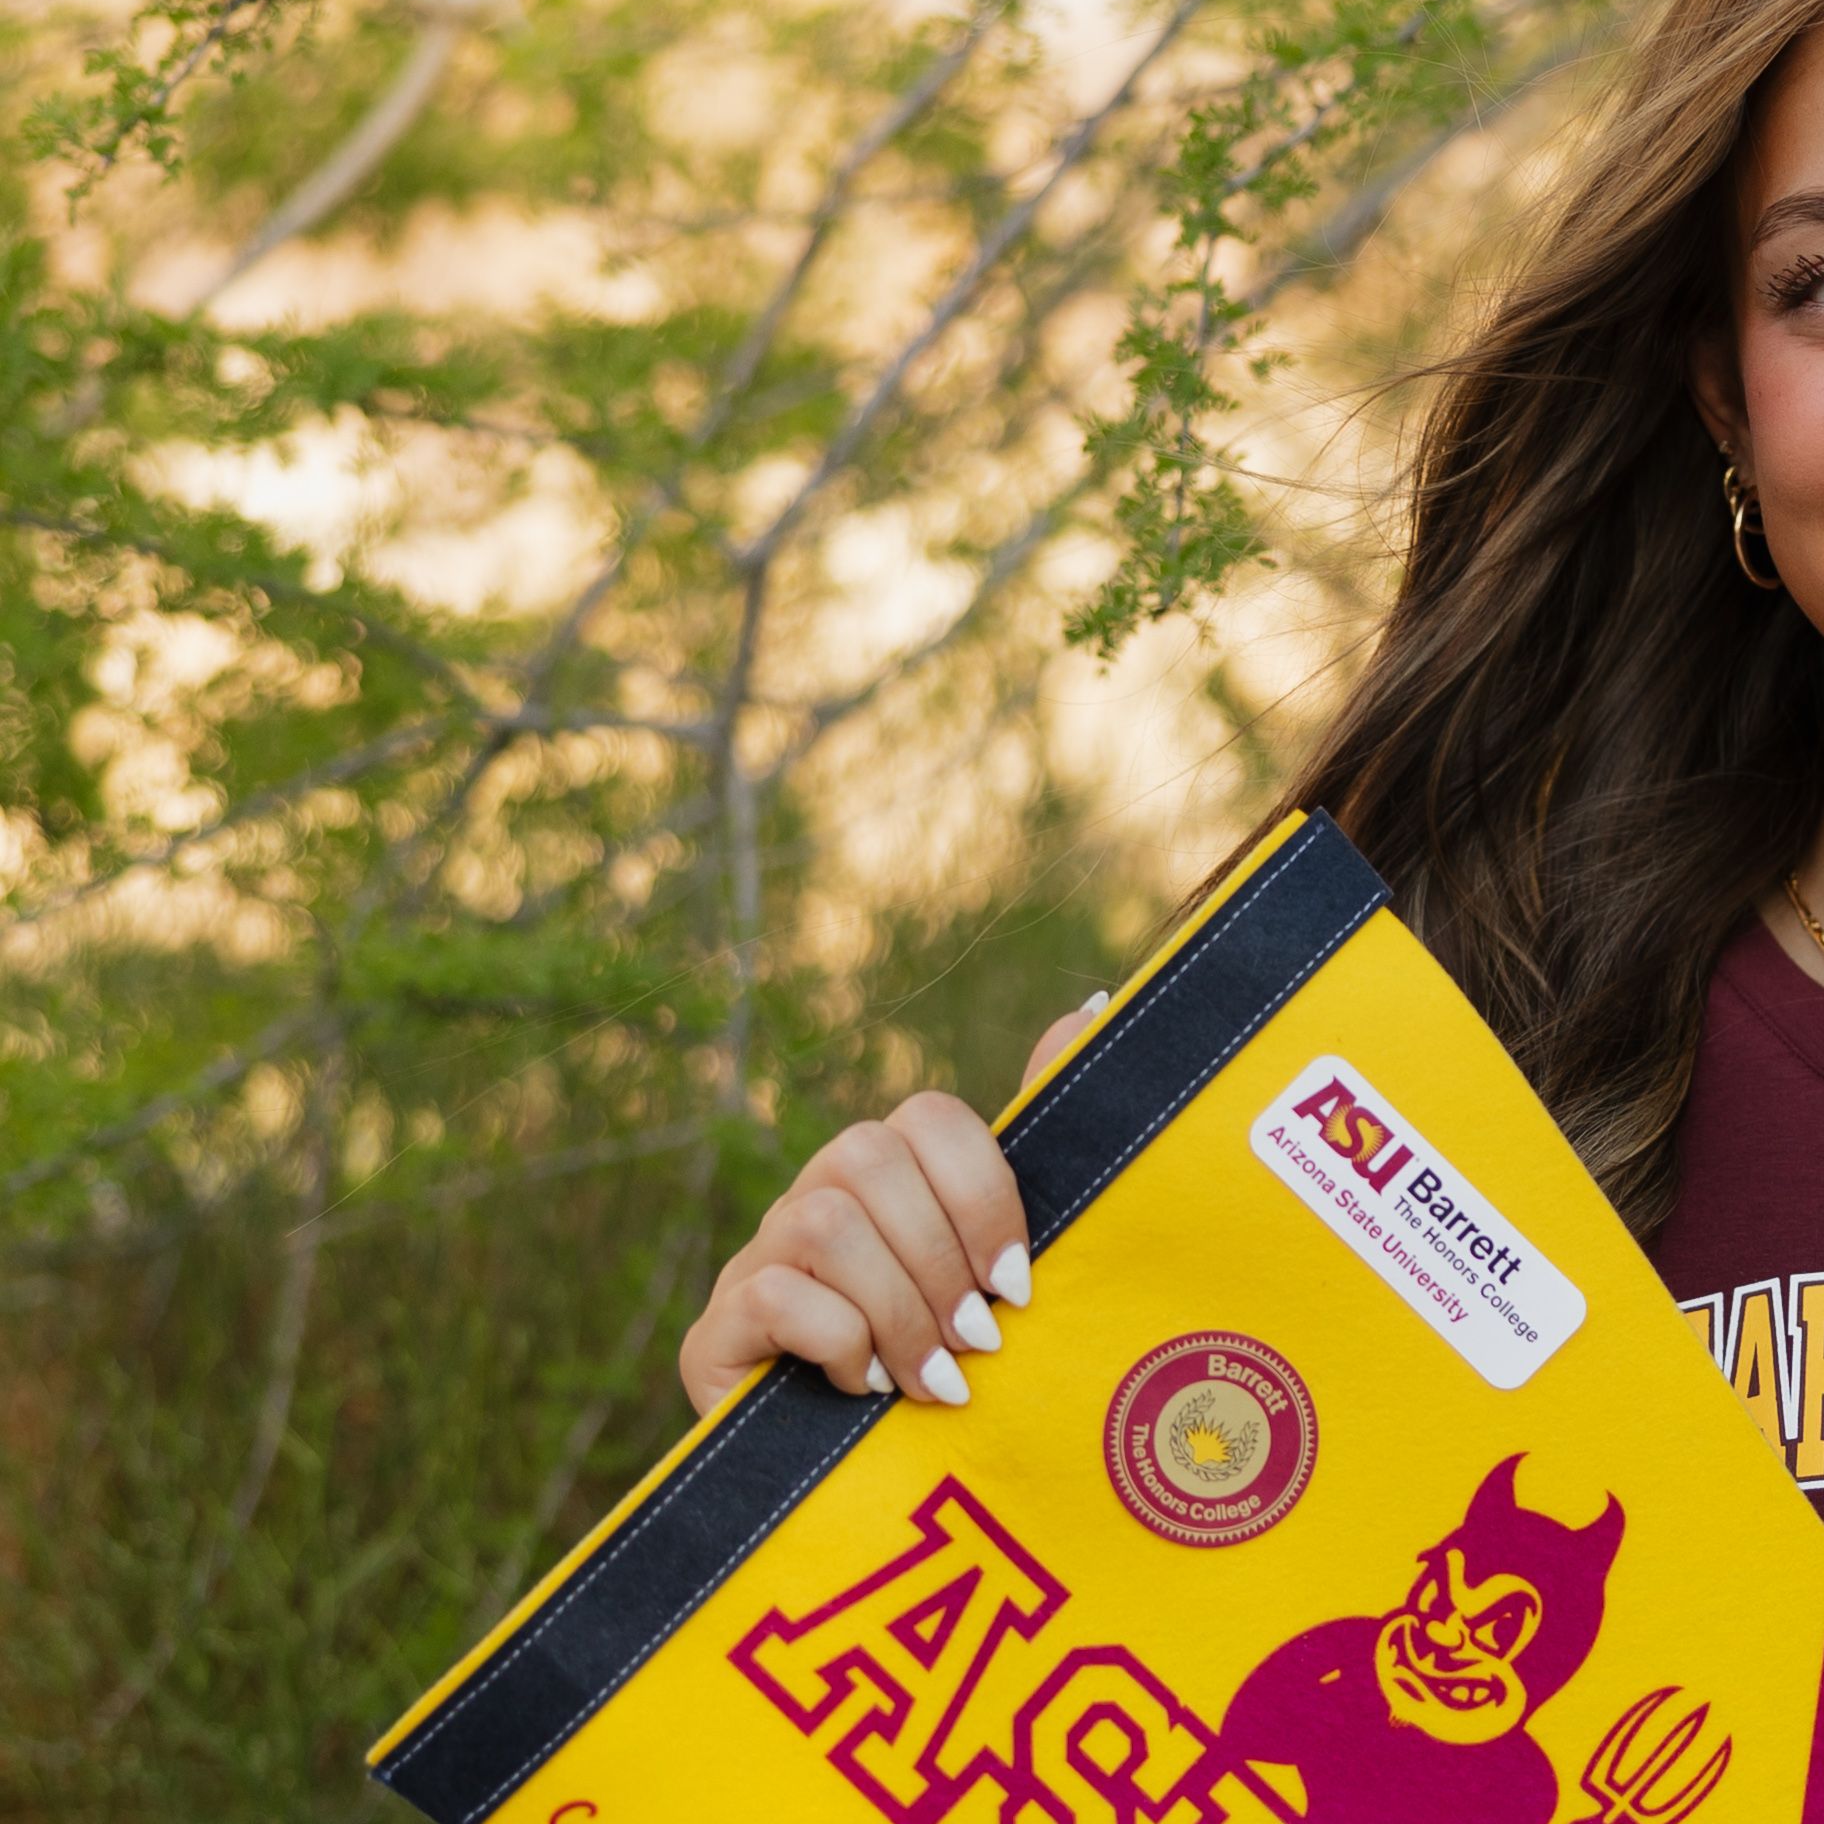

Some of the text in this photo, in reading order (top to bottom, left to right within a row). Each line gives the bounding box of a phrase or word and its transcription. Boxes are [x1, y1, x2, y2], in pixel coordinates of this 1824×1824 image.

[1267, 1125, 1469, 1323] Arizona State University
[1292, 1076, 1522, 1285] ASU Barrett
[1393, 1196, 1538, 1344] The Honors College
[1207, 1354, 1288, 1415] Barrett
[1132, 1422, 1262, 1521] The Honors College
